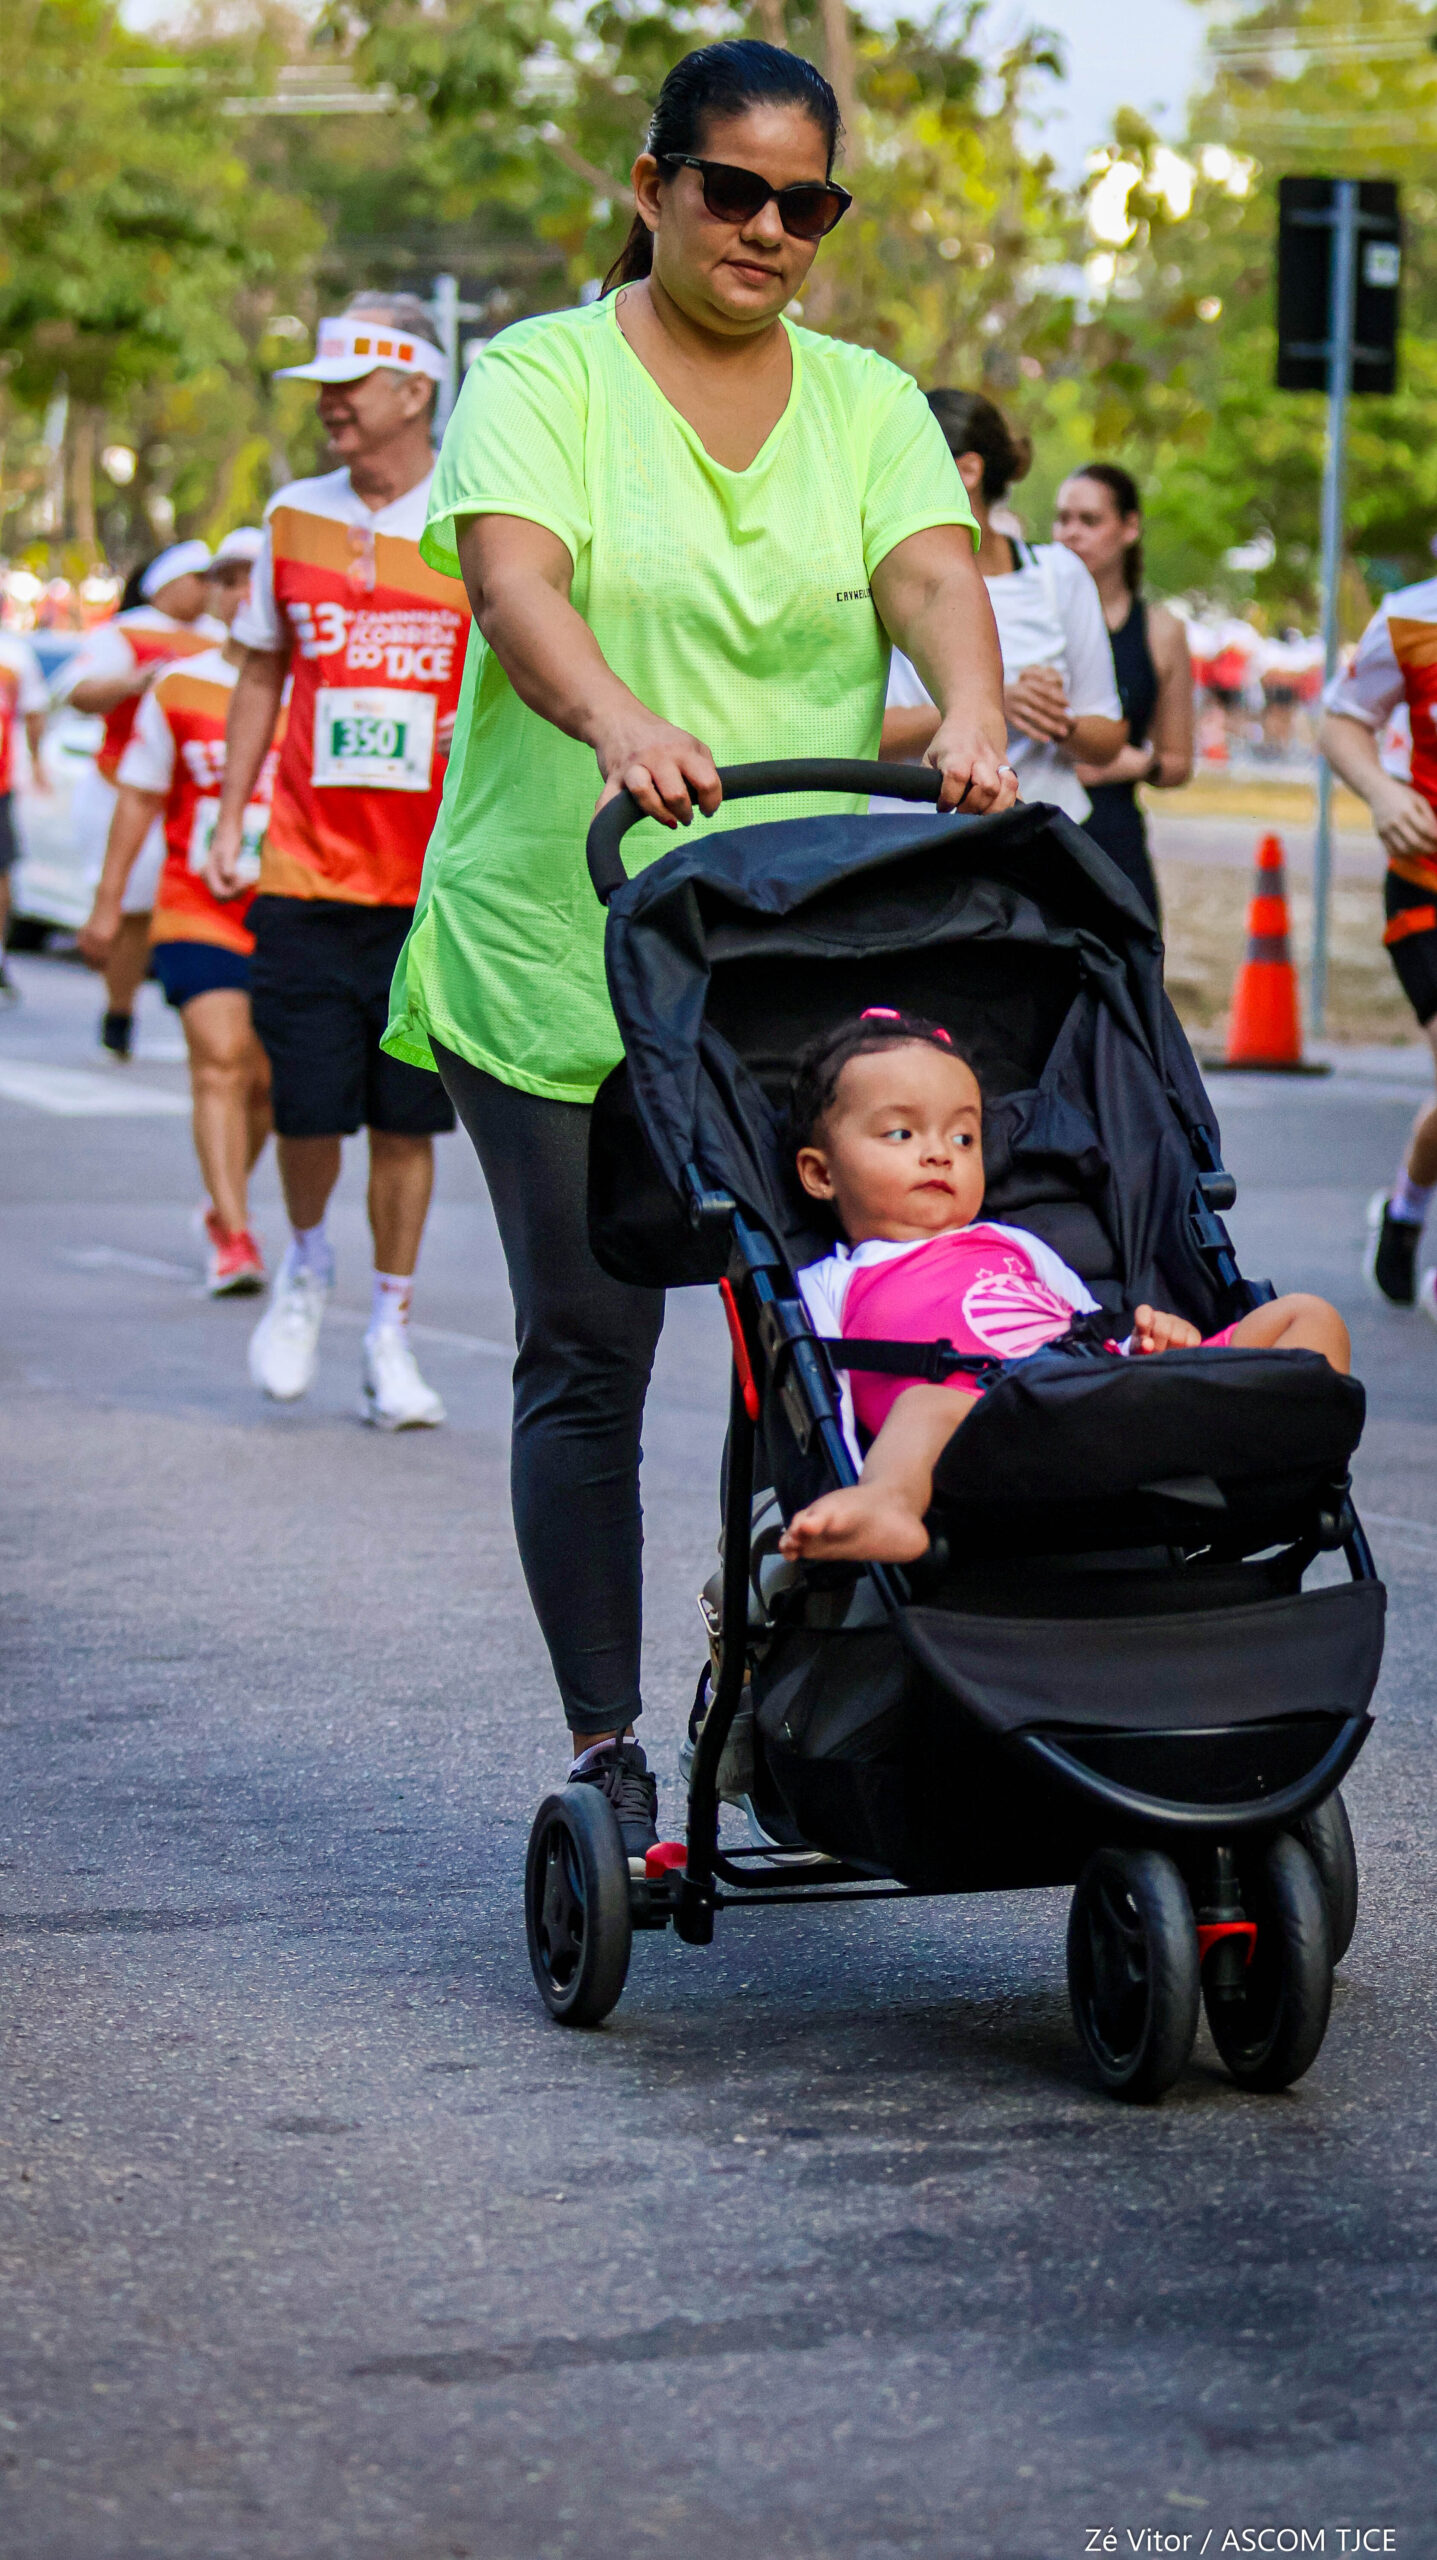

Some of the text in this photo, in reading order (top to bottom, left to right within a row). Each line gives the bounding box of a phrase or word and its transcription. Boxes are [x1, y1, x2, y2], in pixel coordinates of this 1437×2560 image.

[346, 645, 452, 680] DO TJCE
[341, 721, 398, 755] 350
